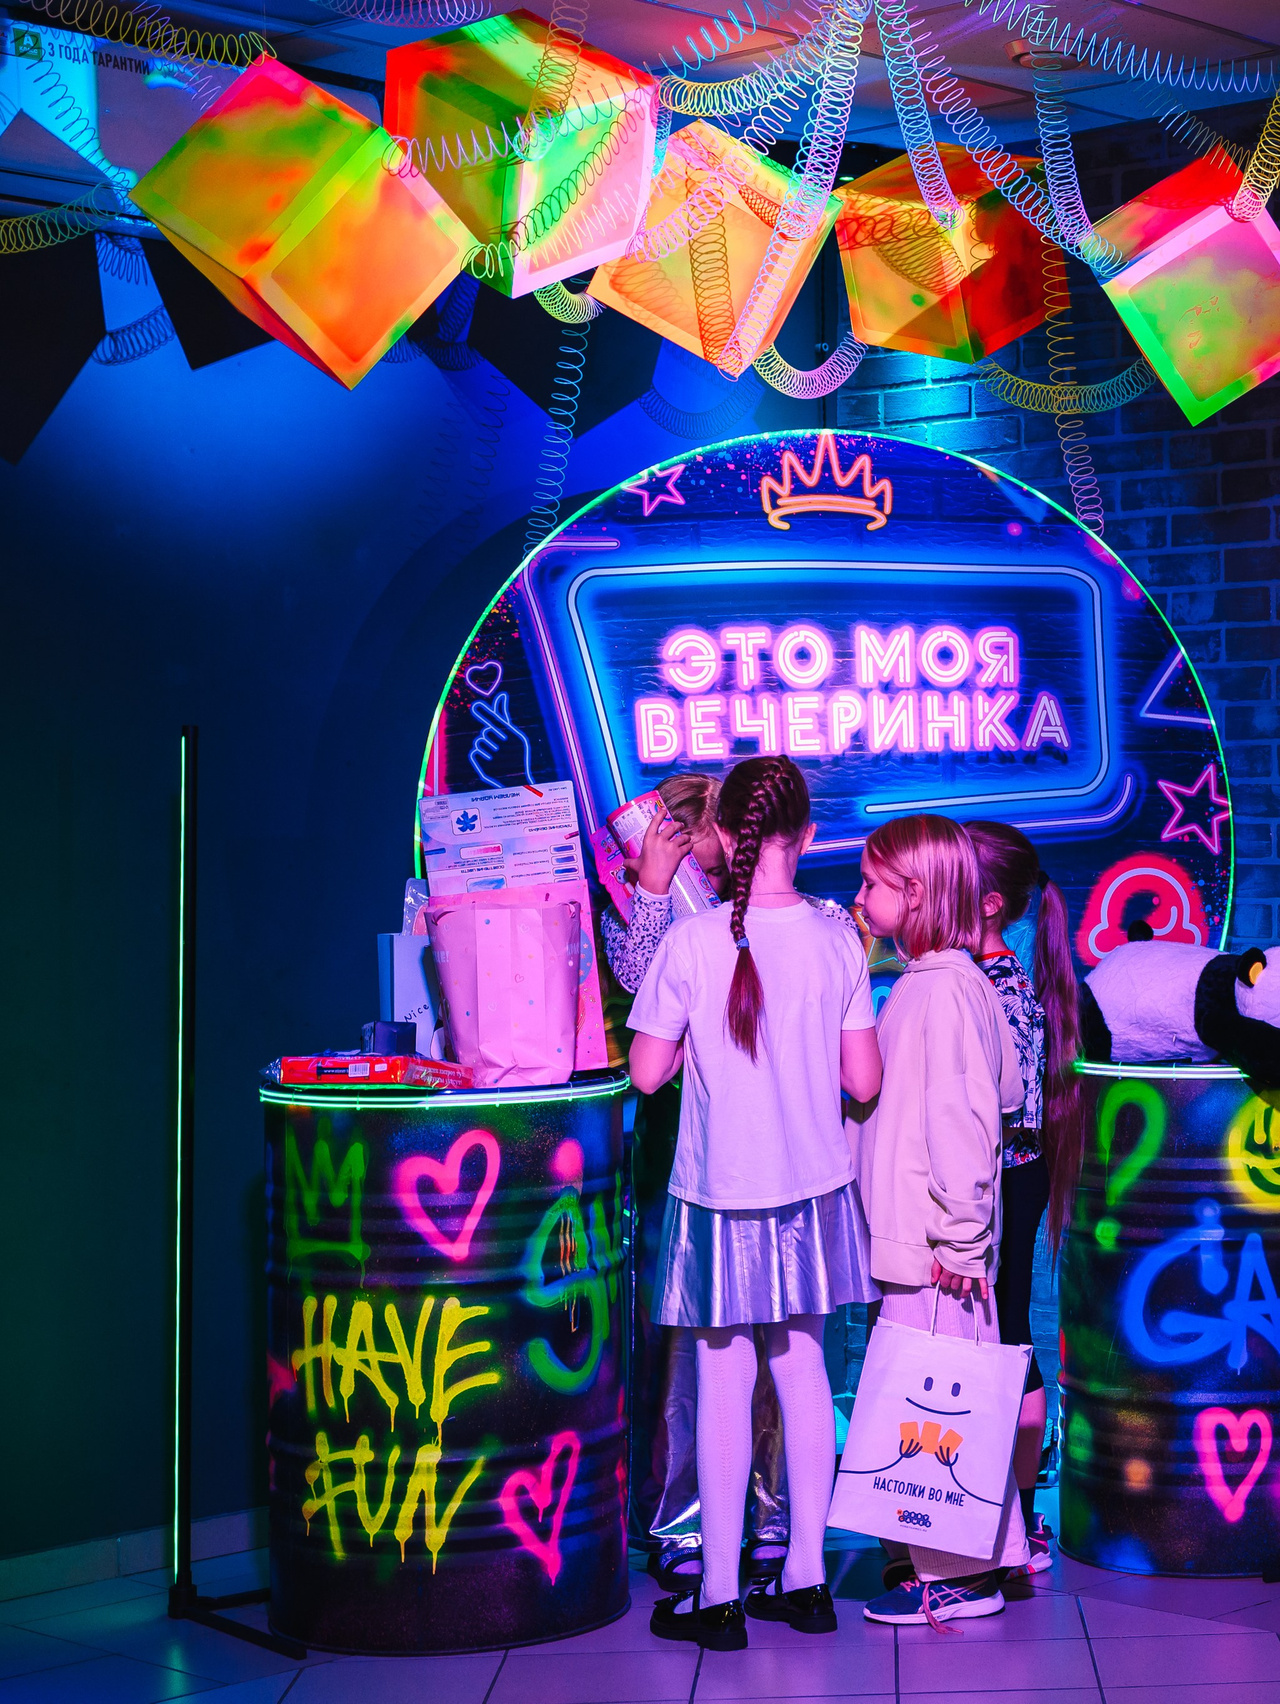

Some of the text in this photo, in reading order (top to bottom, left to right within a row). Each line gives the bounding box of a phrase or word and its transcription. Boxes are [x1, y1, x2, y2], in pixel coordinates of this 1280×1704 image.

[48, 42, 150, 75] 3 ГОДА ГАРАНТИИ
[662, 625, 1021, 694] ЭТО МОЯ
[635, 692, 1072, 764] ВЕЧЕРИНКА
[404, 1003, 430, 1023] Nice
[292, 1294, 500, 1432] HAVE
[302, 1431, 486, 1570] FUN
[873, 1476, 966, 1507] НАСТОЛКИ ВО МНЕ
